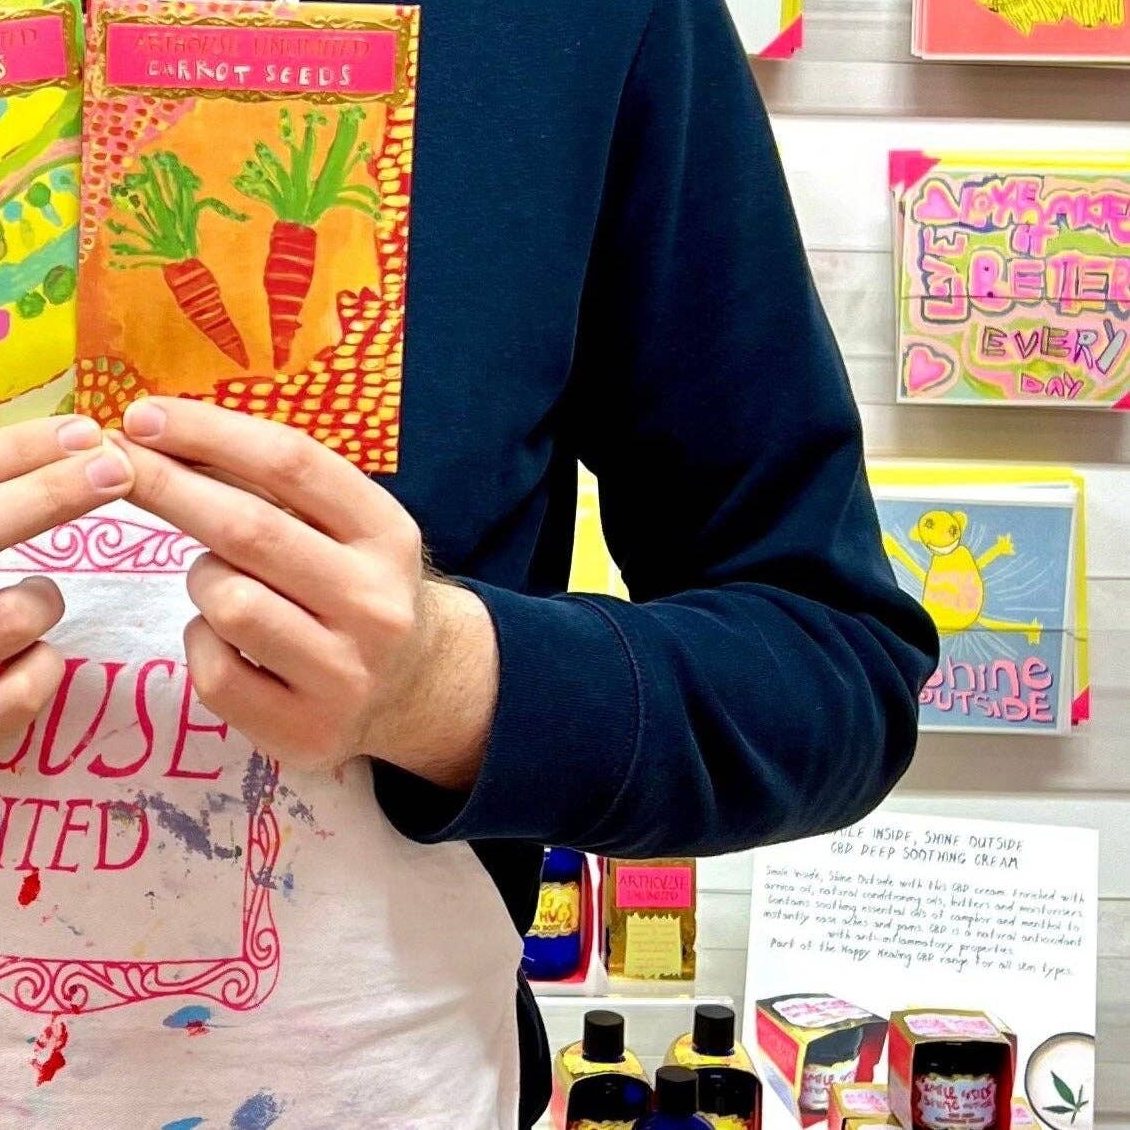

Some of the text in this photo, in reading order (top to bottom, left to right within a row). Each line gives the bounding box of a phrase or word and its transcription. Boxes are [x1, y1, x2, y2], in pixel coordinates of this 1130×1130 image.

[148, 61, 350, 86] CARROT SEEDS
[982, 319, 1127, 375] EVERY
[1020, 371, 1084, 399] DAY
[873, 827, 917, 846] INSIDE,
[924, 830, 960, 846] SHINE
[969, 836, 1023, 852] OUTSIDE
[831, 841, 1019, 869] CBD DEEP SOOTHING CREAM
[820, 886, 858, 898] natural
[863, 889, 921, 911] conditioning
[951, 895, 990, 909] butters
[995, 901, 1015, 912] and
[900, 877, 922, 888] with
[928, 878, 946, 891] this
[952, 882, 969, 893] CBD
[1061, 892, 1085, 905] with
[763, 910, 809, 926] instantly
[875, 918, 891, 929] and
[976, 929, 1016, 941] natural
[816, 900, 856, 919] soothing
[862, 904, 905, 917] essential
[911, 909, 926, 919] oils
[932, 910, 943, 919] of
[951, 913, 990, 928] camphor
[997, 916, 1016, 927] and
[1022, 917, 1061, 930] menthol
[1068, 921, 1080, 931] to
[828, 929, 850, 940] with
[770, 936, 794, 948] Part
[800, 940, 812, 950] of
[820, 942, 836, 953] the
[841, 945, 870, 962] Happy
[878, 947, 911, 968] Healing
[940, 956, 967, 973] range
[976, 956, 993, 969] for
